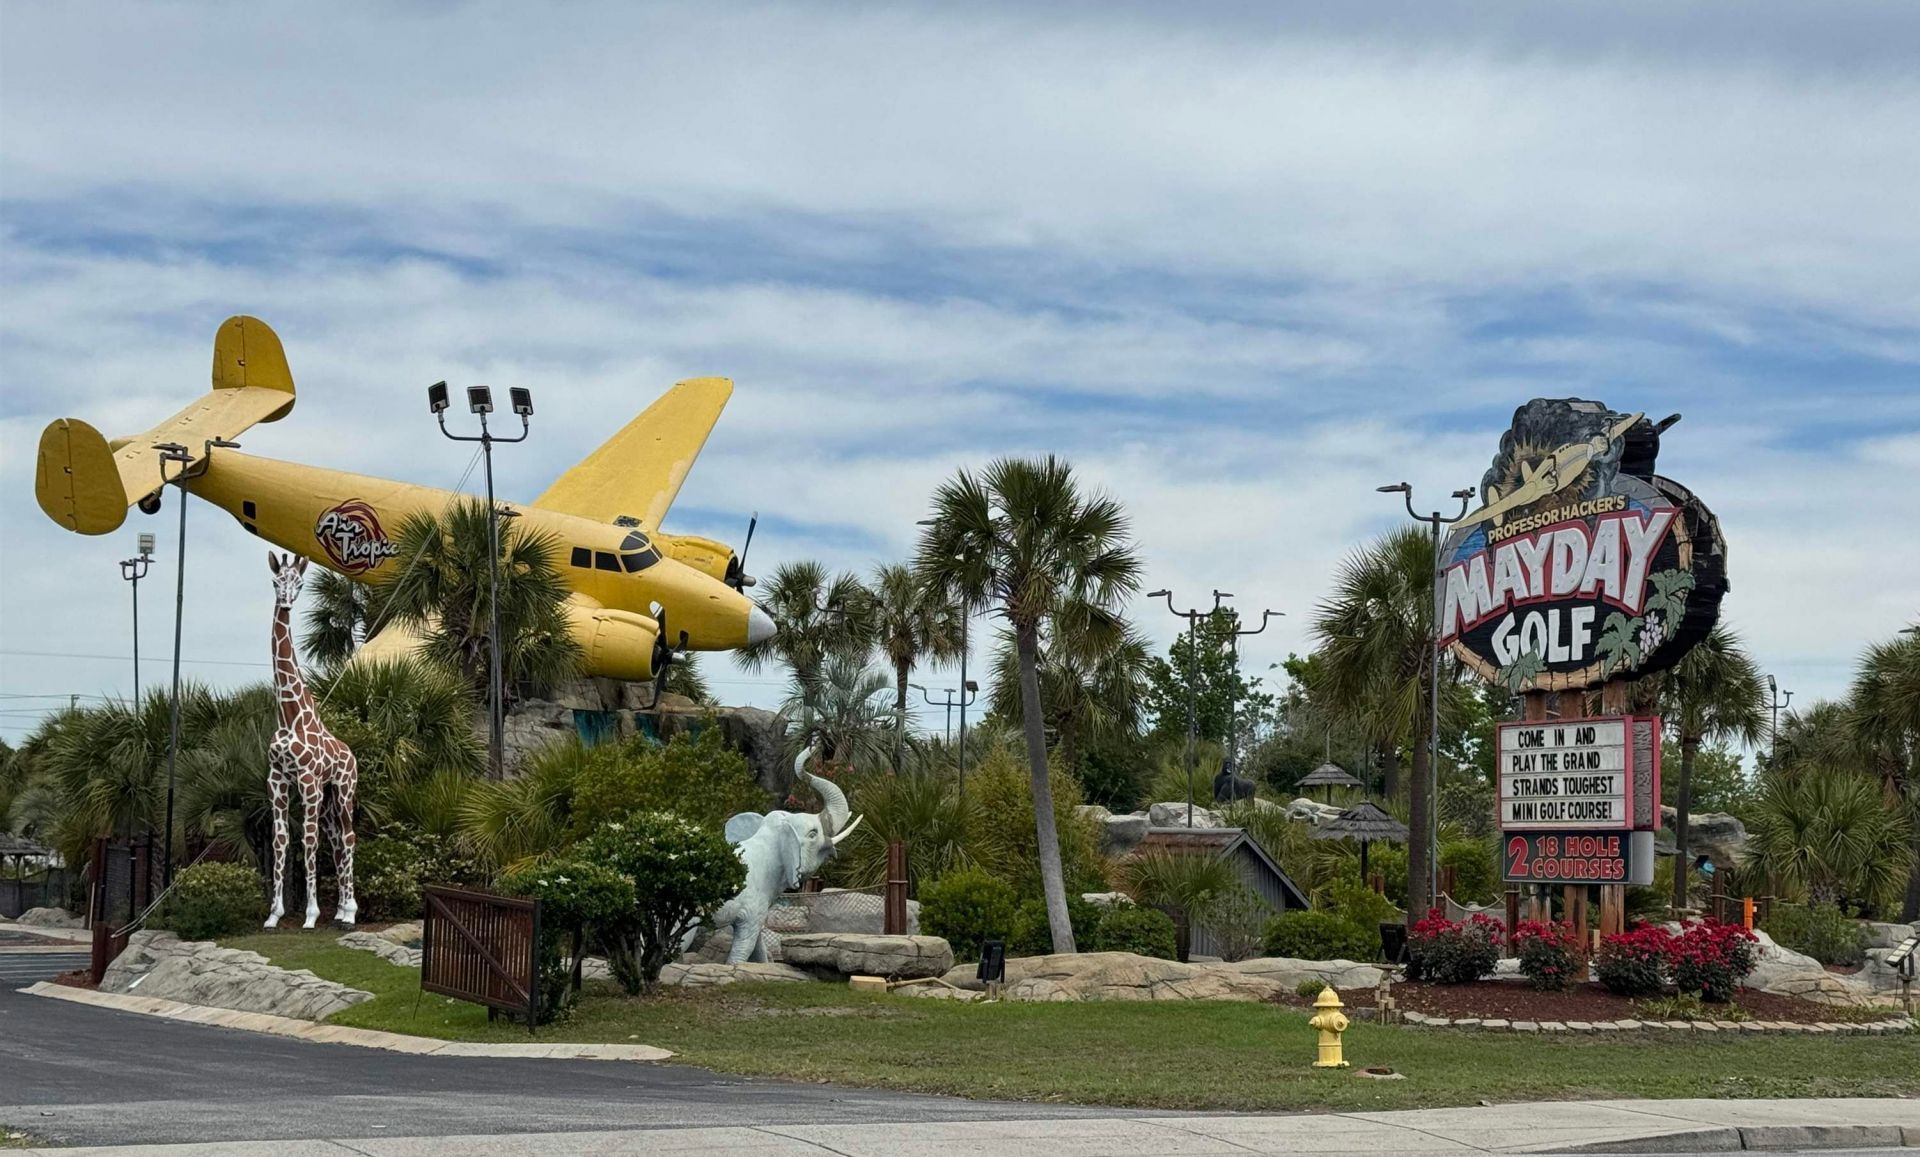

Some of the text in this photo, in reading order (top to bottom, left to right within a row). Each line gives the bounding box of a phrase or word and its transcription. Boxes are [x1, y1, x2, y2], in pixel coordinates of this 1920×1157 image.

[316, 511, 363, 536] Air
[1487, 495, 1626, 544] PROFESSOR HACKER'S
[1440, 509, 1678, 643] MAYDAY
[1491, 605, 1596, 667] GOLF
[1518, 727, 1596, 748] COME IN AND
[1512, 751, 1601, 772] PLAY THE GRAND
[1513, 776, 1614, 796] STRANDS TOUGHEST
[1512, 801, 1612, 820] MINI GOLF COURSE!
[1508, 835, 1529, 876] 2
[1536, 835, 1620, 857] 18 HOLE
[1531, 858, 1625, 880] COURSES
